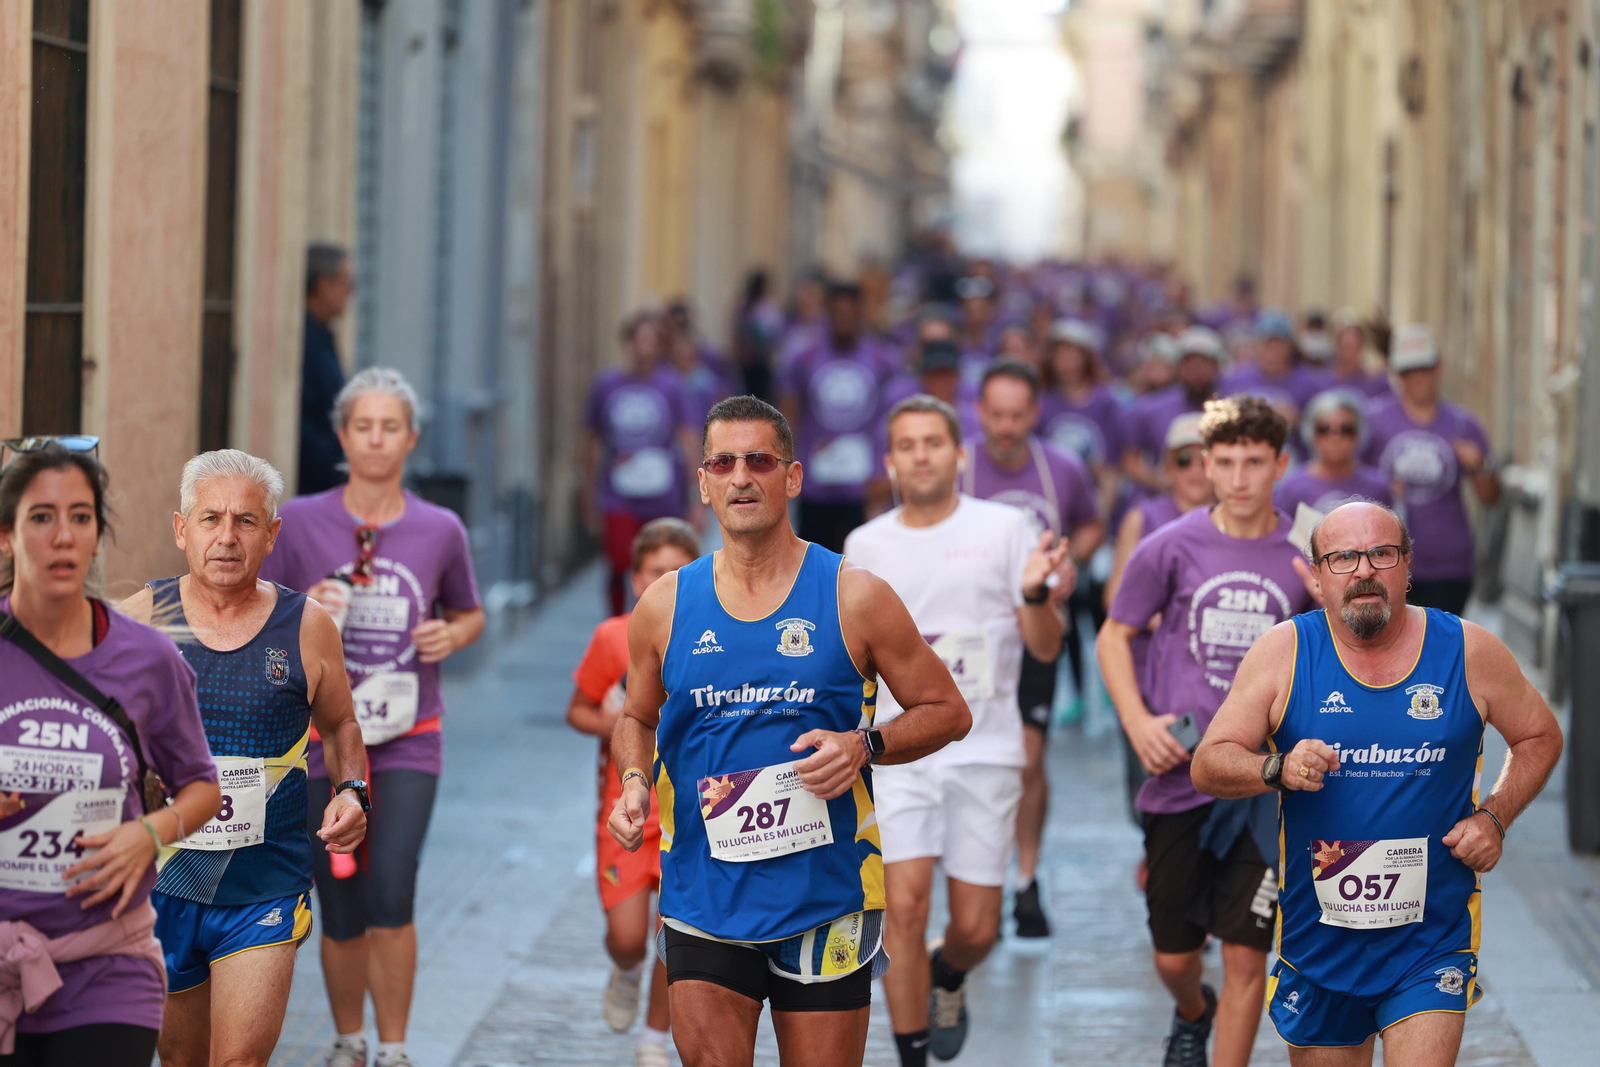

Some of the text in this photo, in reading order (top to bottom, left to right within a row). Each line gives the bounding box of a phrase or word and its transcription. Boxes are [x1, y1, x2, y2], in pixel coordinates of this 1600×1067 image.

[1218, 588, 1268, 612] 25N
[692, 645, 724, 654] austral
[690, 680, 816, 708] Tirabuzón
[354, 700, 387, 719] 34
[18, 719, 88, 750] 25N
[1326, 742, 1446, 764] irabuzón
[13, 760, 84, 776] 24 HORAS
[222, 768, 260, 777] CARRERA
[776, 770, 798, 780] CARR
[737, 797, 791, 833] 287
[225, 822, 251, 833] CERO
[717, 820, 825, 848] TU LUCHA ES MI LUCHA
[18, 830, 84, 858] 234
[1387, 847, 1423, 856] CARRERA
[0, 862, 35, 872] OMPE
[38, 864, 48, 873] EL
[1324, 902, 1333, 910] TU
[1333, 903, 1362, 912] LUCHA
[1378, 903, 1388, 911] MI
[1391, 900, 1420, 911] LUCHA
